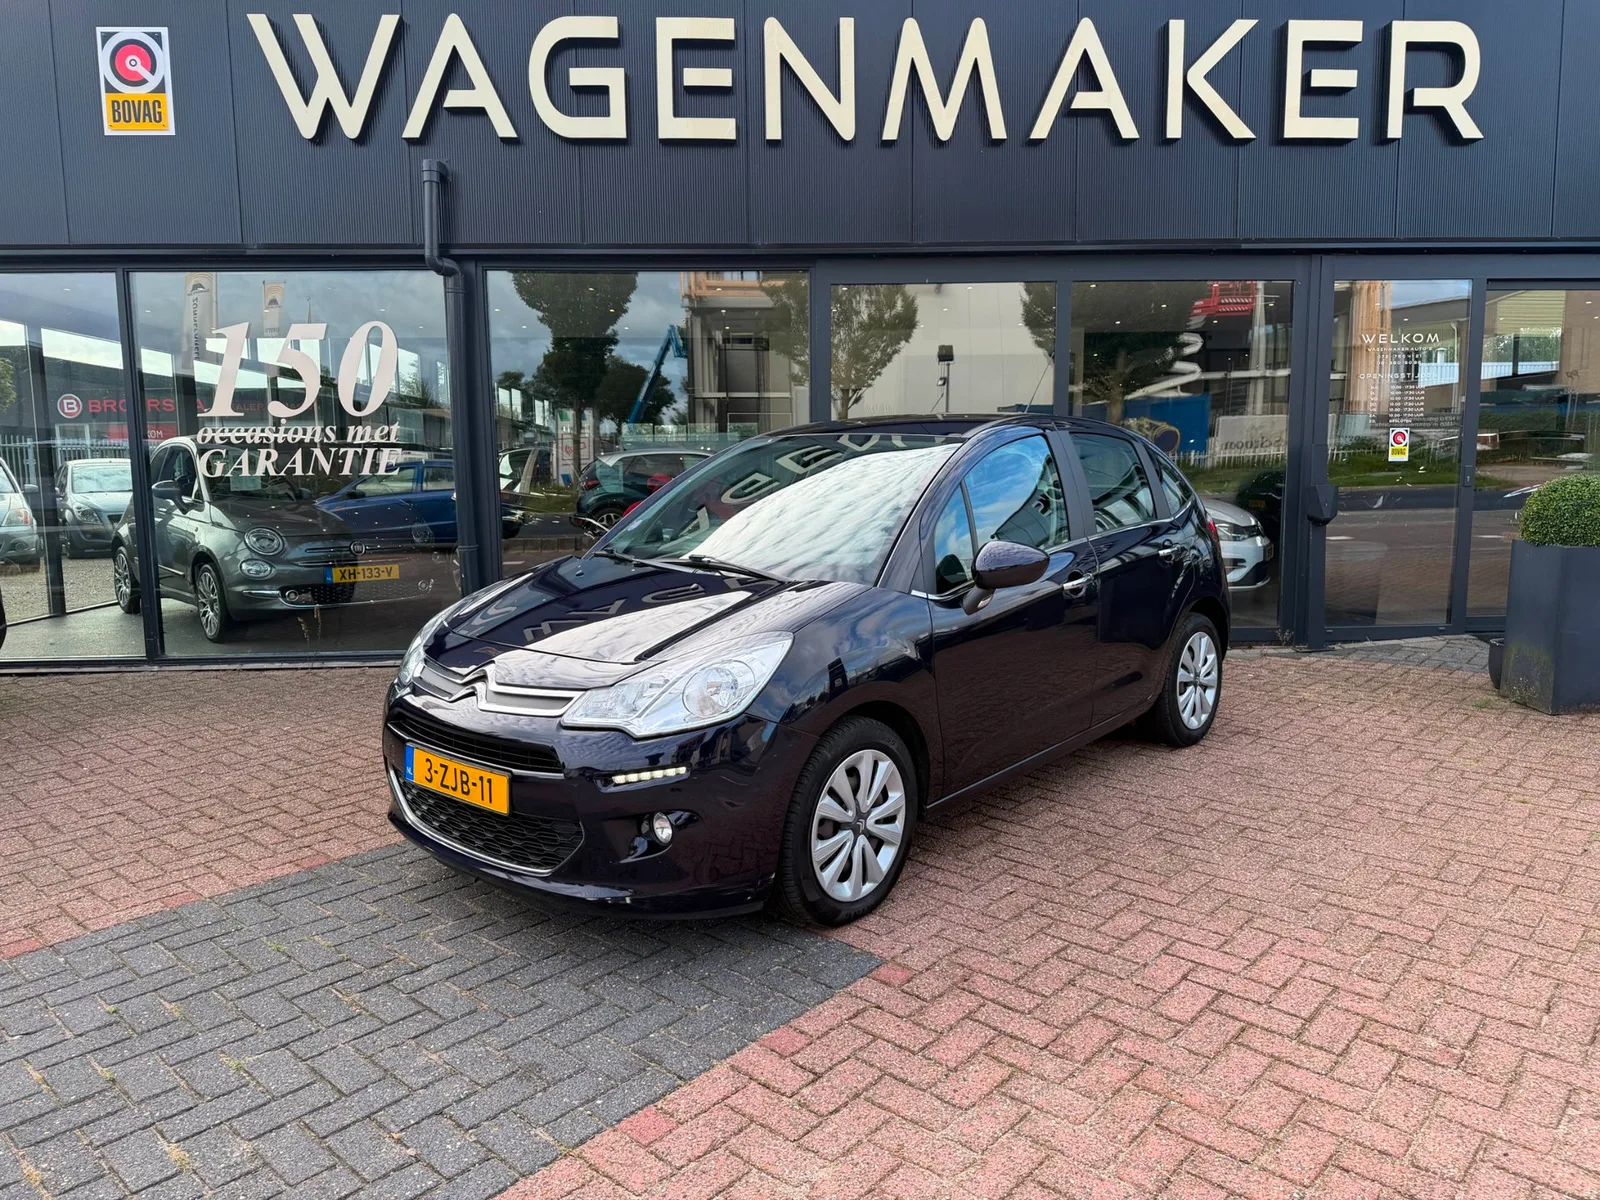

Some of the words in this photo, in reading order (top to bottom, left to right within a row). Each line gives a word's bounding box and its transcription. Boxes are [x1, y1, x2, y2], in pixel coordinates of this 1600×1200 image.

[247, 13, 1484, 141] WAGENMAKER
[111, 100, 162, 123] BOVAG
[1361, 333, 1440, 344] WELKOM
[197, 320, 398, 418] 150
[196, 418, 337, 445] occasions
[346, 421, 400, 444] met
[200, 447, 403, 478] GARANTIE
[339, 566, 393, 580] XH-133-V
[425, 758, 493, 803] 3-ZJB-11
